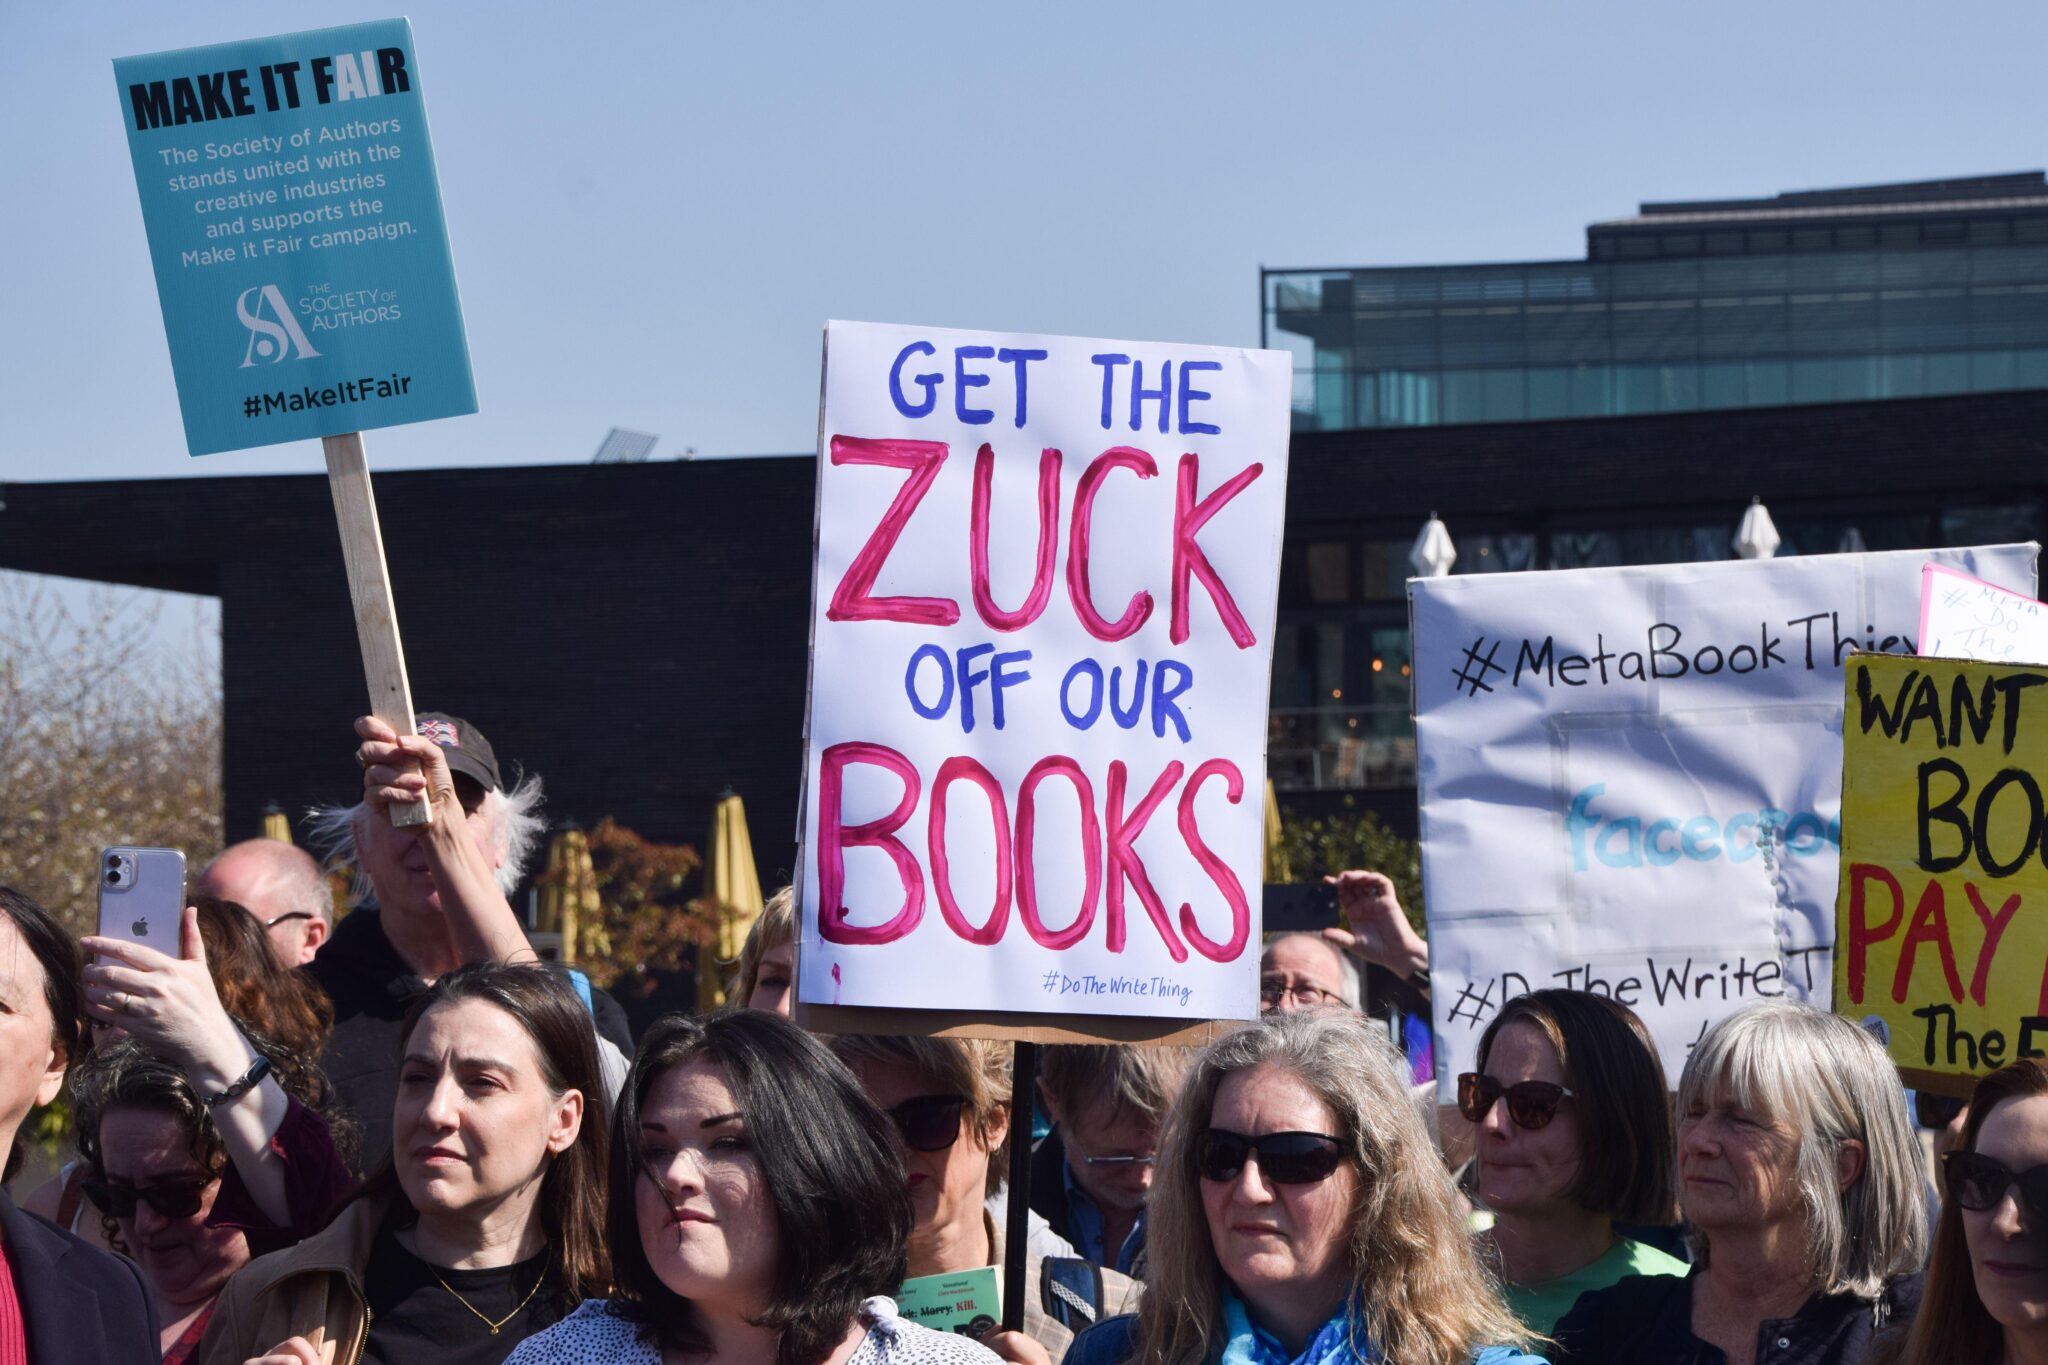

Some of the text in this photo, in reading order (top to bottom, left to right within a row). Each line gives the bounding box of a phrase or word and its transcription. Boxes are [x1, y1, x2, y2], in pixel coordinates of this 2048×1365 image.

[129, 47, 411, 131] MAKE IT FAIR
[158, 118, 401, 166] The Society of Authors
[169, 144, 401, 192] stands united with the
[195, 172, 386, 214] creative industries
[206, 199, 384, 238] and supports the
[182, 221, 417, 268] Make it Fair campaign.
[299, 289, 397, 315] SOCIETY OF
[308, 283, 331, 295] THE
[312, 305, 401, 332] AUTHORS
[244, 373, 411, 418] #MakeItFair
[889, 340, 1223, 435] GET THE
[825, 434, 1264, 650] ZUCK
[1452, 610, 1918, 698] #MetaBookThie
[905, 642, 1193, 744] OFF OUR
[1857, 664, 2048, 756] WANT
[1915, 757, 2048, 878] BO
[817, 741, 1250, 963] BOOKS
[1847, 862, 2022, 1007] PAY
[1043, 970, 1193, 1006] #DoTheWriteThing
[1912, 1003, 2006, 1070] The
